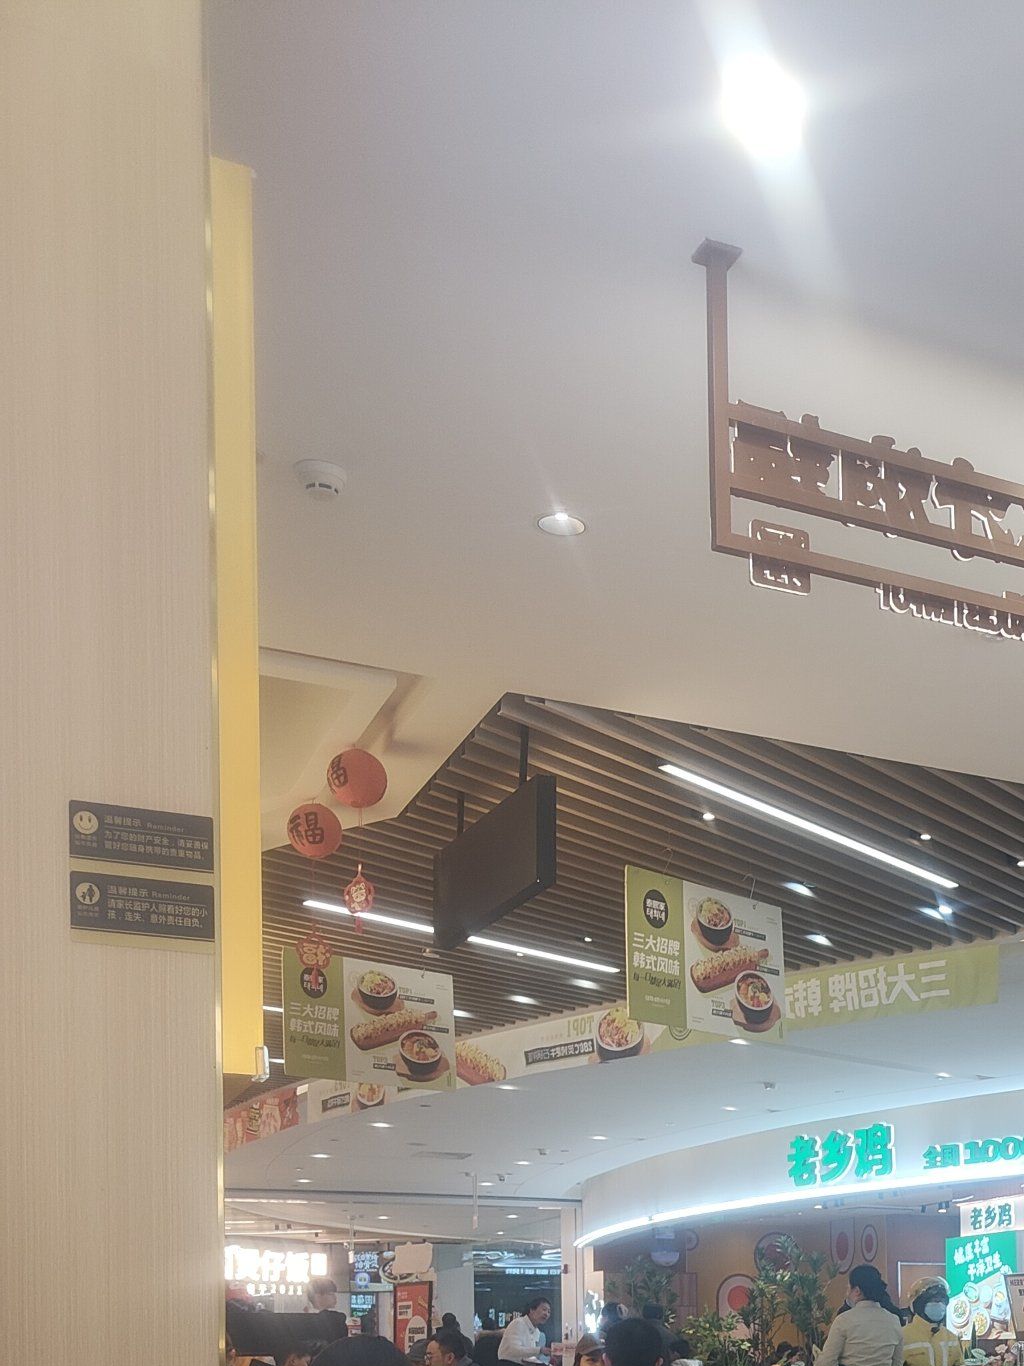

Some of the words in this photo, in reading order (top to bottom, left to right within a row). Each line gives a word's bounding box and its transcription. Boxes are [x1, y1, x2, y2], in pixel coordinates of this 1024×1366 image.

[147, 822, 184, 833] Reminder
[289, 811, 325, 848] 福
[152, 891, 190, 901] Reminder
[633, 931, 680, 956] 三大招牌
[633, 951, 680, 977] 韩式风味
[289, 1002, 340, 1022] 三大招牌
[289, 1018, 340, 1038] 韩式风味
[787, 1122, 895, 1186] 老乡鸡
[970, 1202, 1013, 1230] 老乡鸡
